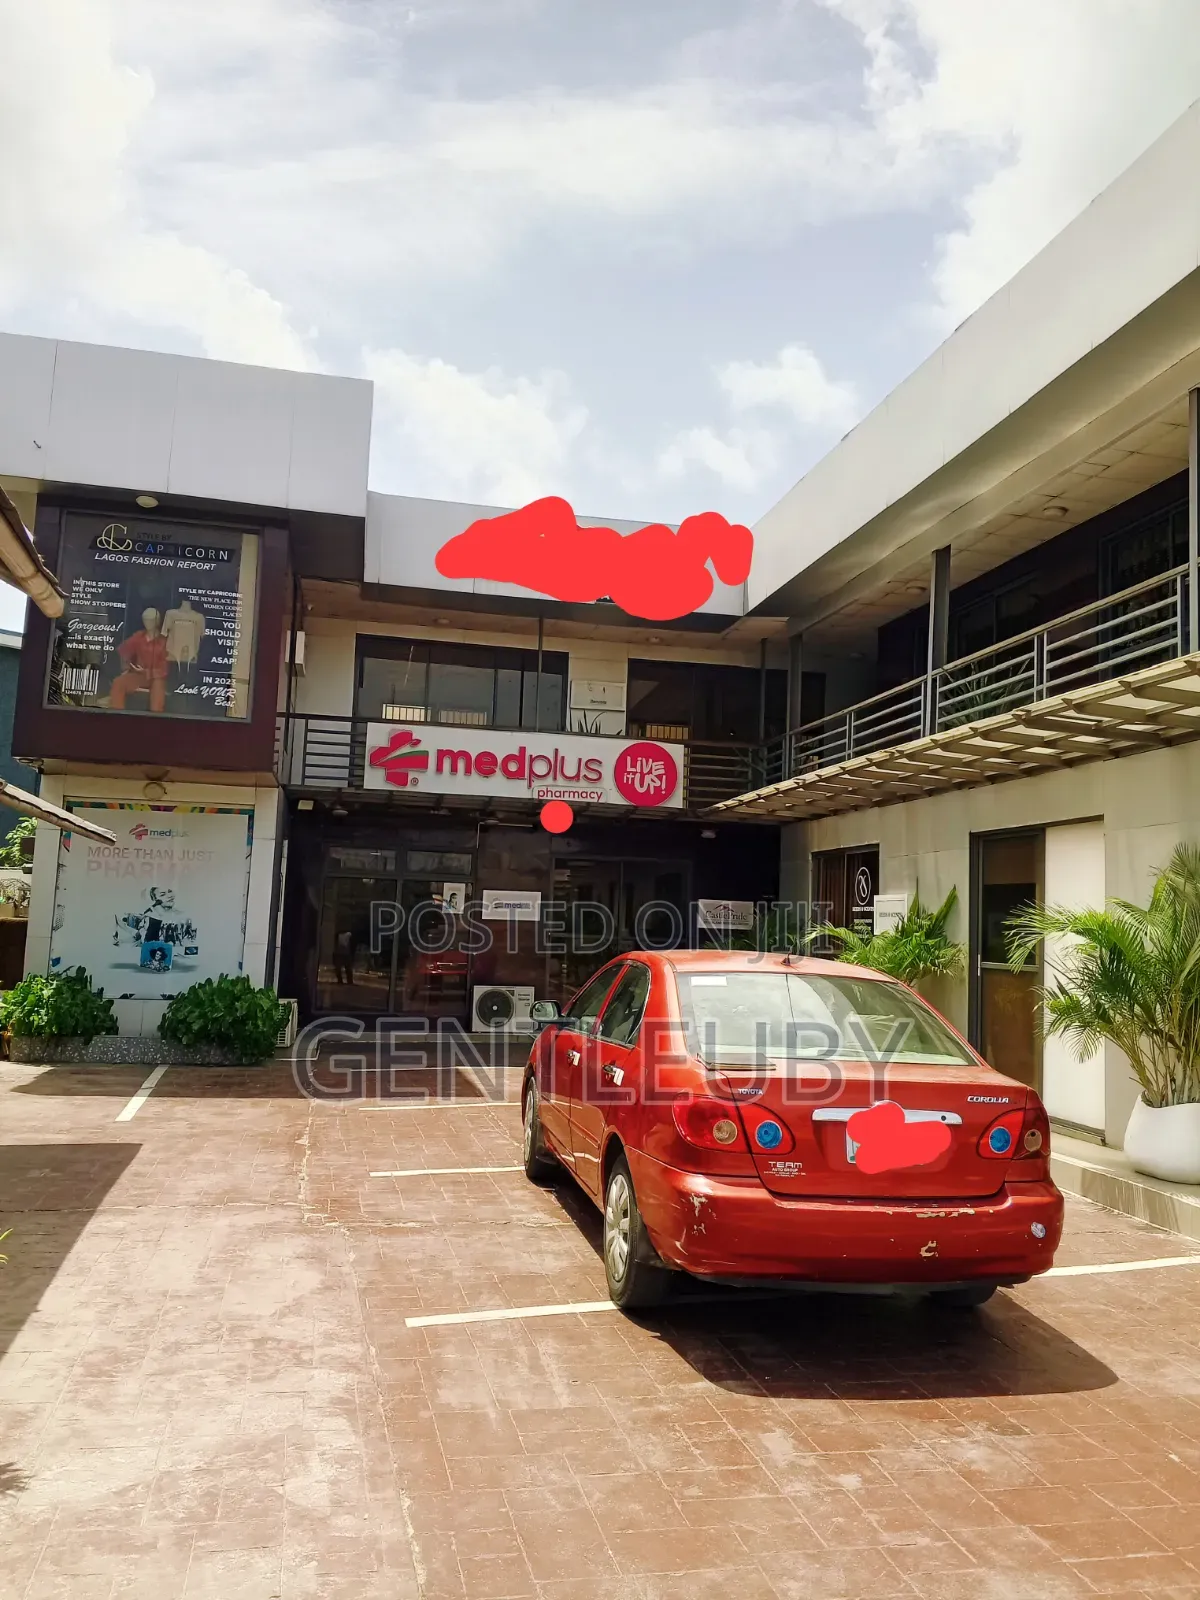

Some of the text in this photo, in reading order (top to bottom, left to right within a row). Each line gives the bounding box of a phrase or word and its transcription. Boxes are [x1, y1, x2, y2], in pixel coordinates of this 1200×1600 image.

[136, 532, 172, 541] STYLE BY
[135, 542, 228, 560] CAPICORN
[94, 552, 217, 571] LAGOS FASHION REPORT
[92, 601, 127, 609] STOPPERS
[67, 618, 124, 634] Gorgeous!
[222, 621, 241, 630] YOU
[204, 628, 241, 638] SHOULD
[83, 635, 114, 643] exactly
[217, 638, 240, 647] VISIT
[66, 641, 87, 650] what
[88, 643, 101, 651] we
[226, 648, 239, 656] US
[210, 656, 237, 665] ASAP!
[202, 676, 236, 686] IN 2023
[173, 683, 237, 699] Look YOUR
[214, 696, 236, 708] Best
[436, 745, 604, 789] medplus
[634, 772, 667, 795] UP!
[536, 786, 604, 803] pharmacy
[87, 846, 216, 863] MORE THAN JUST
[967, 1095, 1009, 1104] COROLLA
[768, 1161, 803, 1169] TEAM
